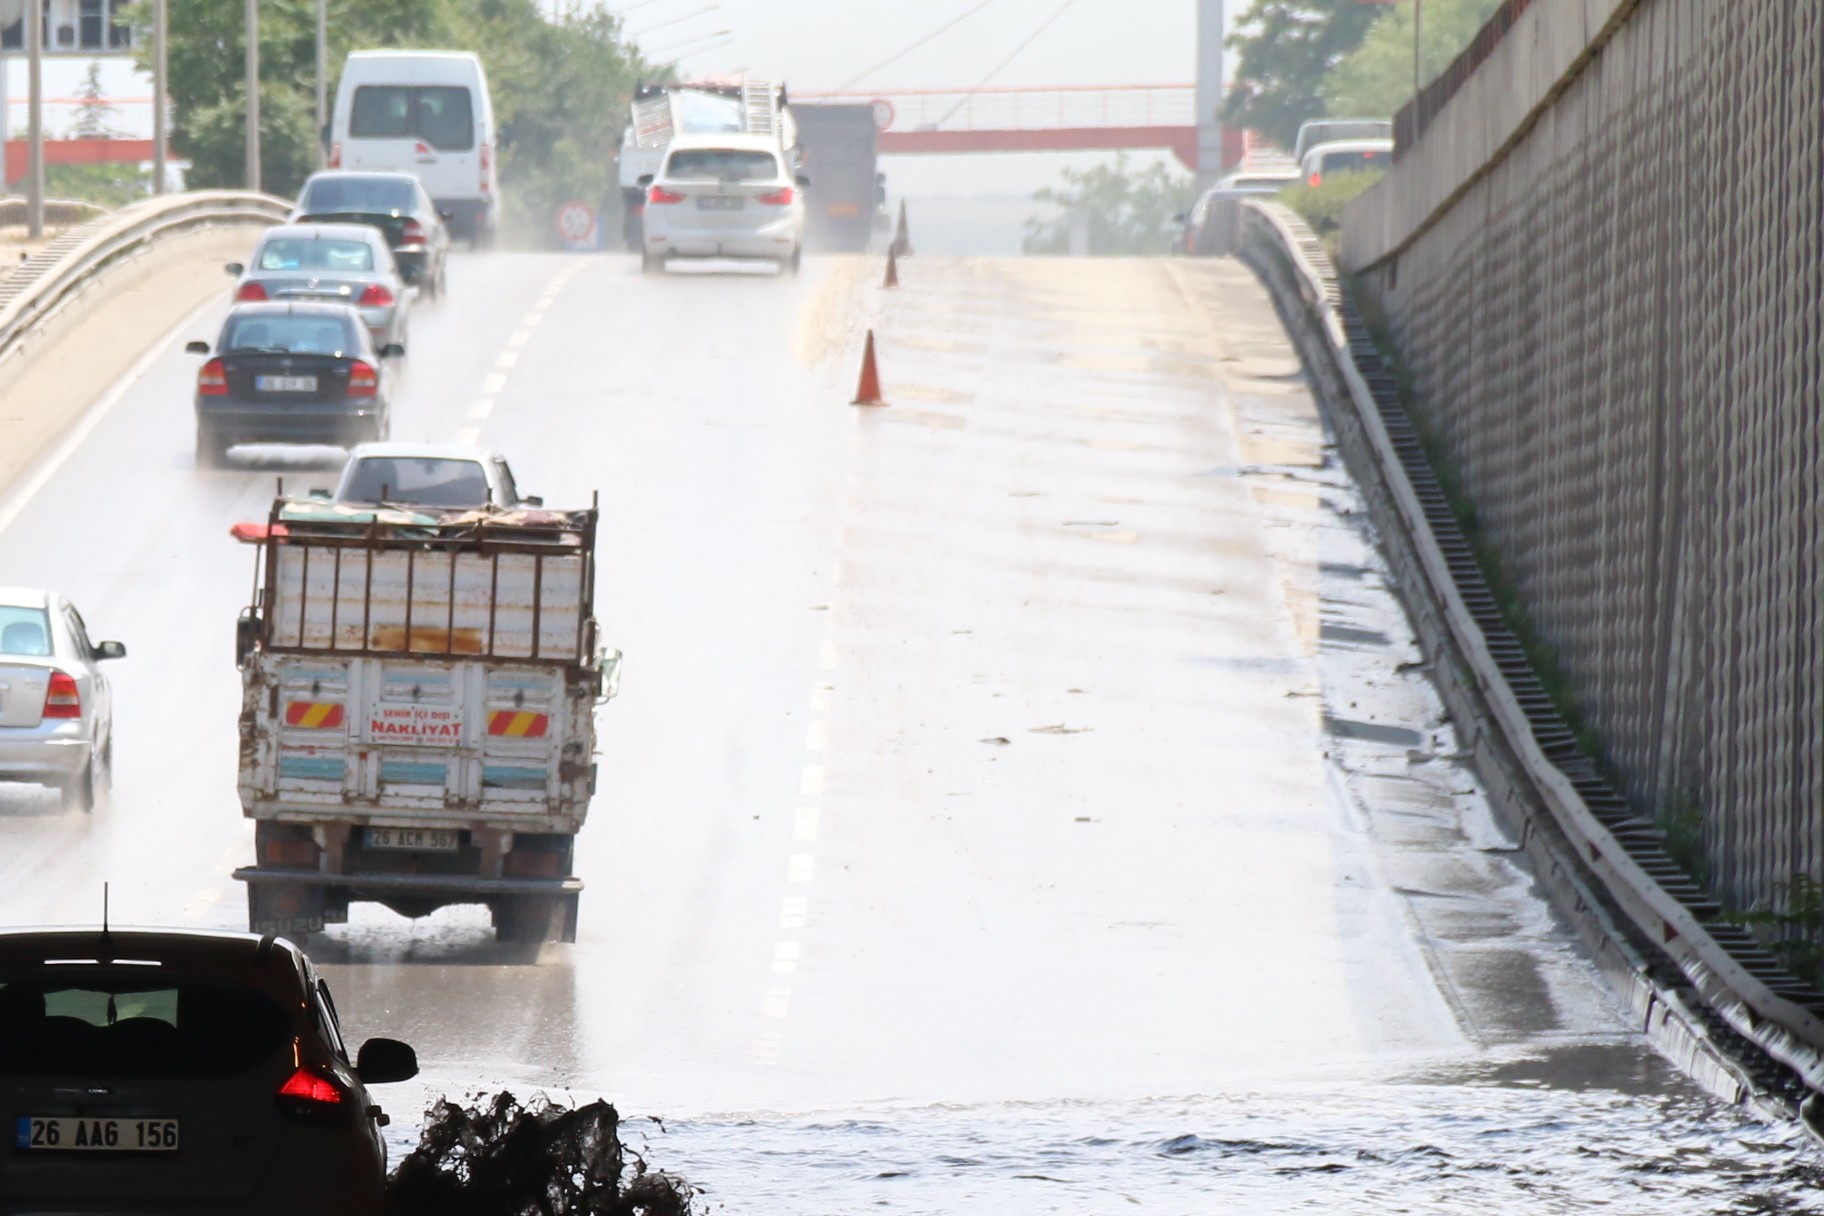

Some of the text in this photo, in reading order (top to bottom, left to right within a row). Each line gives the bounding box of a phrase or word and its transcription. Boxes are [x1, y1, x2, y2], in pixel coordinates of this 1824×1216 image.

[375, 831, 390, 846] 26
[32, 1120, 60, 1146] 26
[136, 1122, 176, 1148] 156
